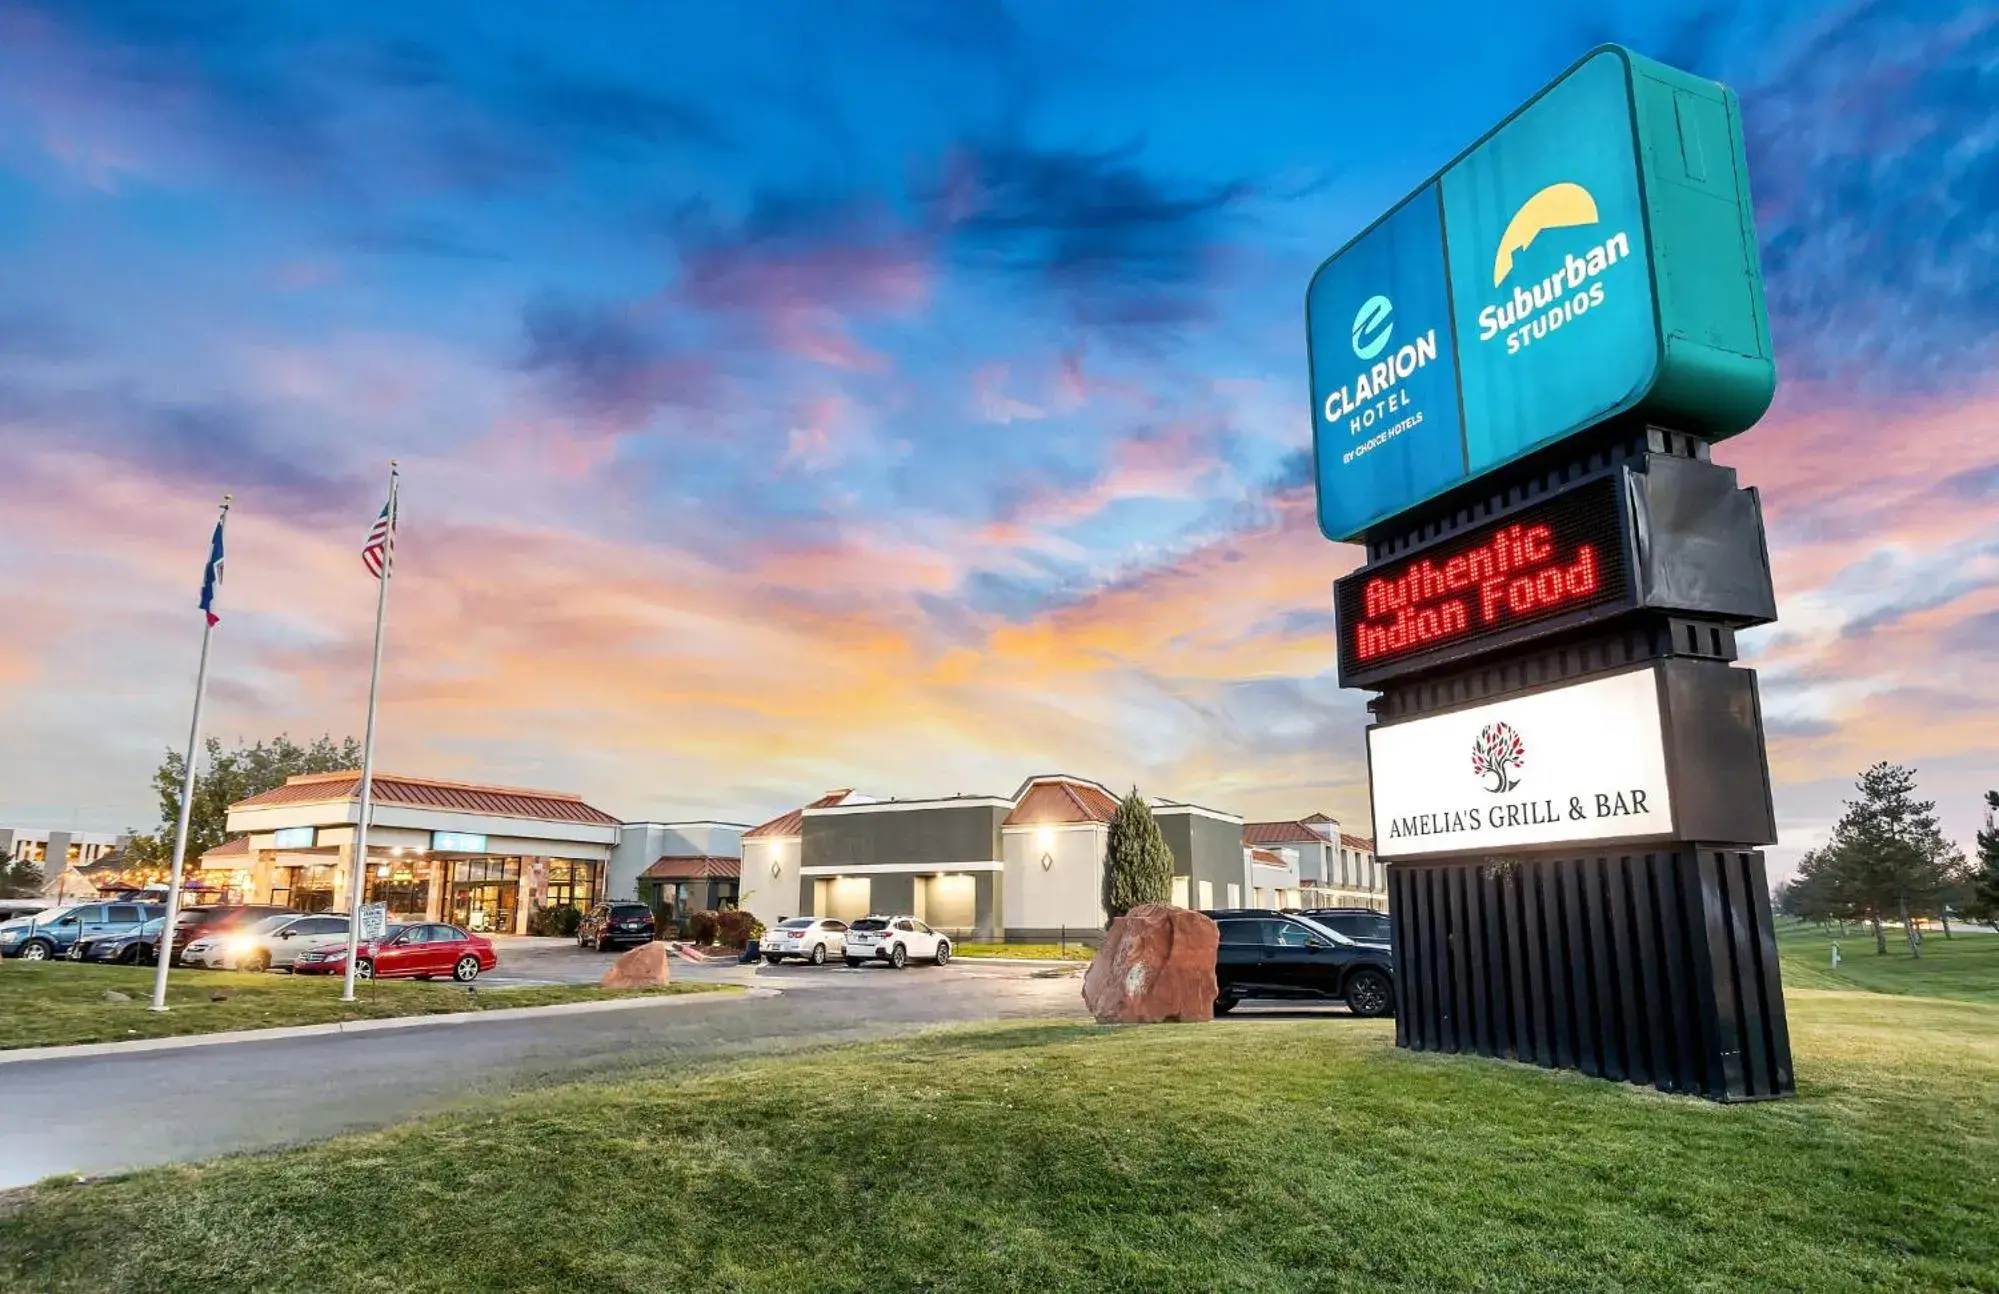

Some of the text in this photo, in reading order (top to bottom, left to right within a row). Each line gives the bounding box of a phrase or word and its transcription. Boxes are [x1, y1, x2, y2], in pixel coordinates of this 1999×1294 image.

[1478, 231, 1630, 341] Suburban
[1506, 281, 1605, 355] STUDIOS
[1324, 328, 1437, 423] CLARION
[1350, 389, 1410, 436] HOTEL
[1343, 411, 1423, 464] BY CHOICE HOTELS
[1355, 544, 1597, 660] Indian Food
[1364, 523, 1552, 619] Authentic
[1389, 789, 1650, 839] AMELIA'S GRILL & BAR
